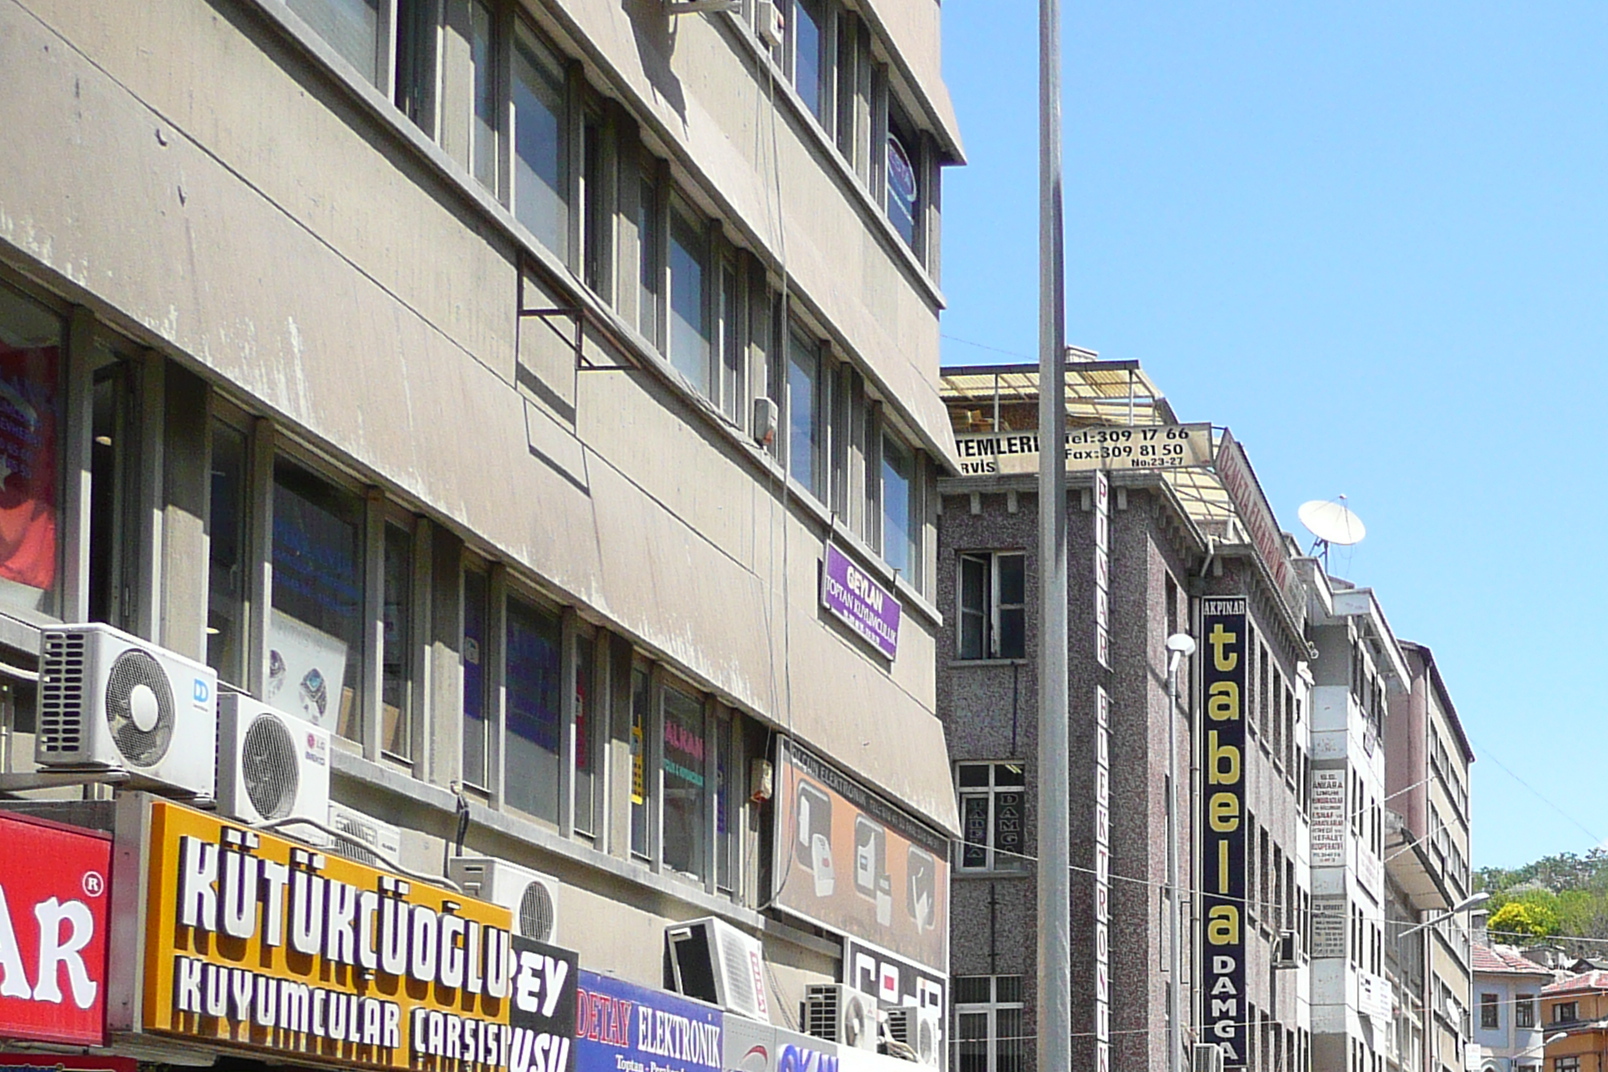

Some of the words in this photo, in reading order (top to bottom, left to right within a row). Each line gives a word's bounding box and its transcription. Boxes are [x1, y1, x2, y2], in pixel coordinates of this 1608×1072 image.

[1139, 444, 1156, 457] 81
[1162, 443, 1184, 456] 50
[1141, 428, 1158, 441] 17
[1166, 427, 1190, 440] 66
[1203, 600, 1246, 616] AKPINAR
[1208, 622, 1242, 947] tabela
[172, 953, 402, 1050] KUYUMCULAR
[575, 988, 632, 1049] DETAY
[637, 1012, 722, 1069] ELEKTRONİK
[1210, 955, 1240, 1061] DAMGA
